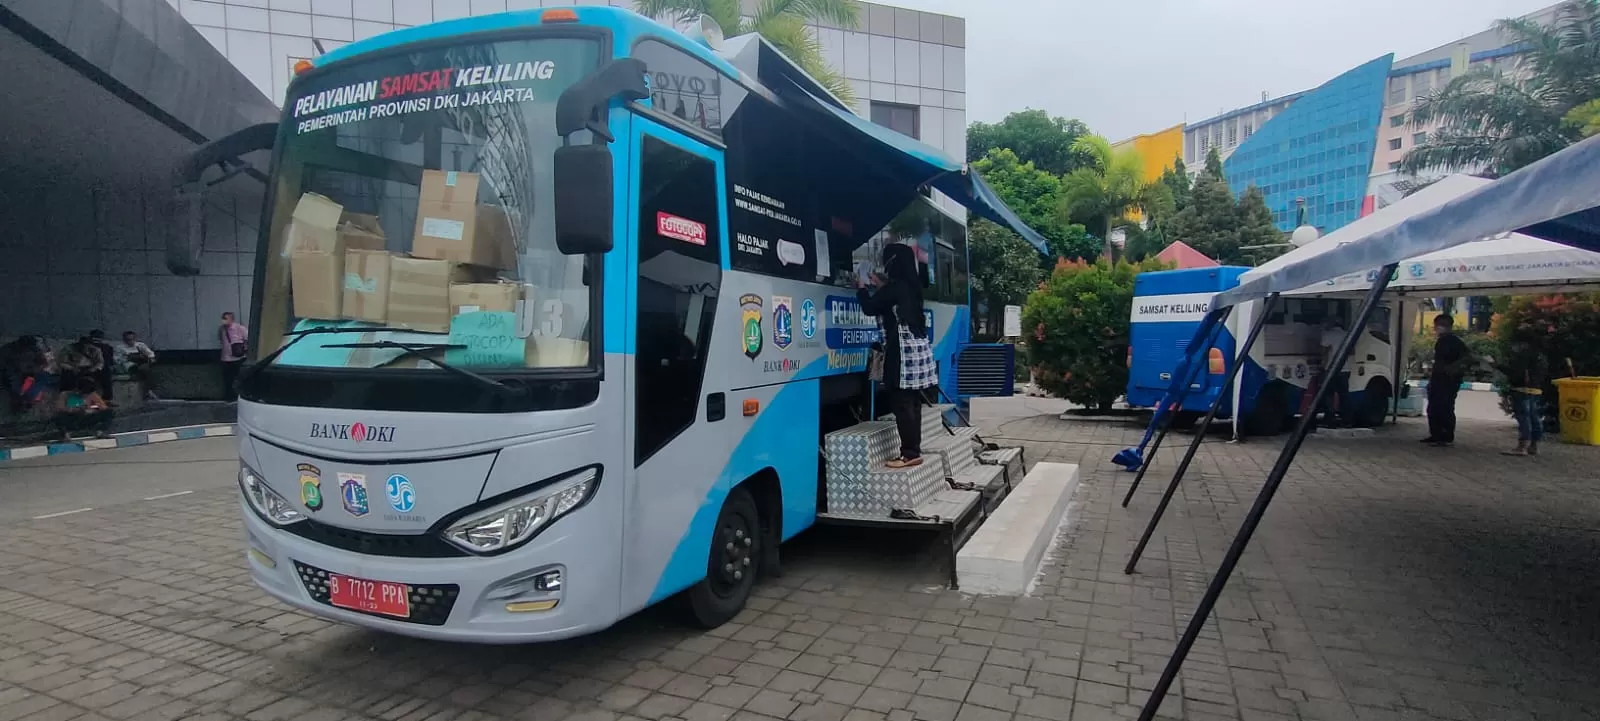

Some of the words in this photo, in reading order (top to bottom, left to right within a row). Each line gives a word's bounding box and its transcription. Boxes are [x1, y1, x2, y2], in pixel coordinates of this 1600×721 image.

[294, 80, 378, 117] PELAYANAN
[379, 68, 454, 99] SAMSAT
[455, 60, 555, 88] KELILING
[297, 108, 367, 135] PEMERINTAH
[368, 97, 431, 120] PROVINSI
[434, 94, 460, 109] DKI
[461, 87, 535, 107] JAKARTA
[660, 217, 704, 239] FOTOCOPY
[737, 232, 754, 247] HALO
[752, 236, 770, 250] PAJAK
[1434, 266, 1459, 274] BANK
[1467, 264, 1487, 273] DKI
[515, 298, 563, 339] U.3
[1139, 305, 1168, 315] SAMSAT
[1170, 303, 1208, 314] KELILING
[764, 359, 783, 373] BANK
[788, 359, 801, 371] DKI
[827, 350, 864, 373] Melayani
[310, 423, 351, 440] BANK
[366, 427, 397, 442] DKI
[331, 577, 340, 594] B
[348, 579, 375, 600] 7712
[382, 584, 405, 605] PPA
